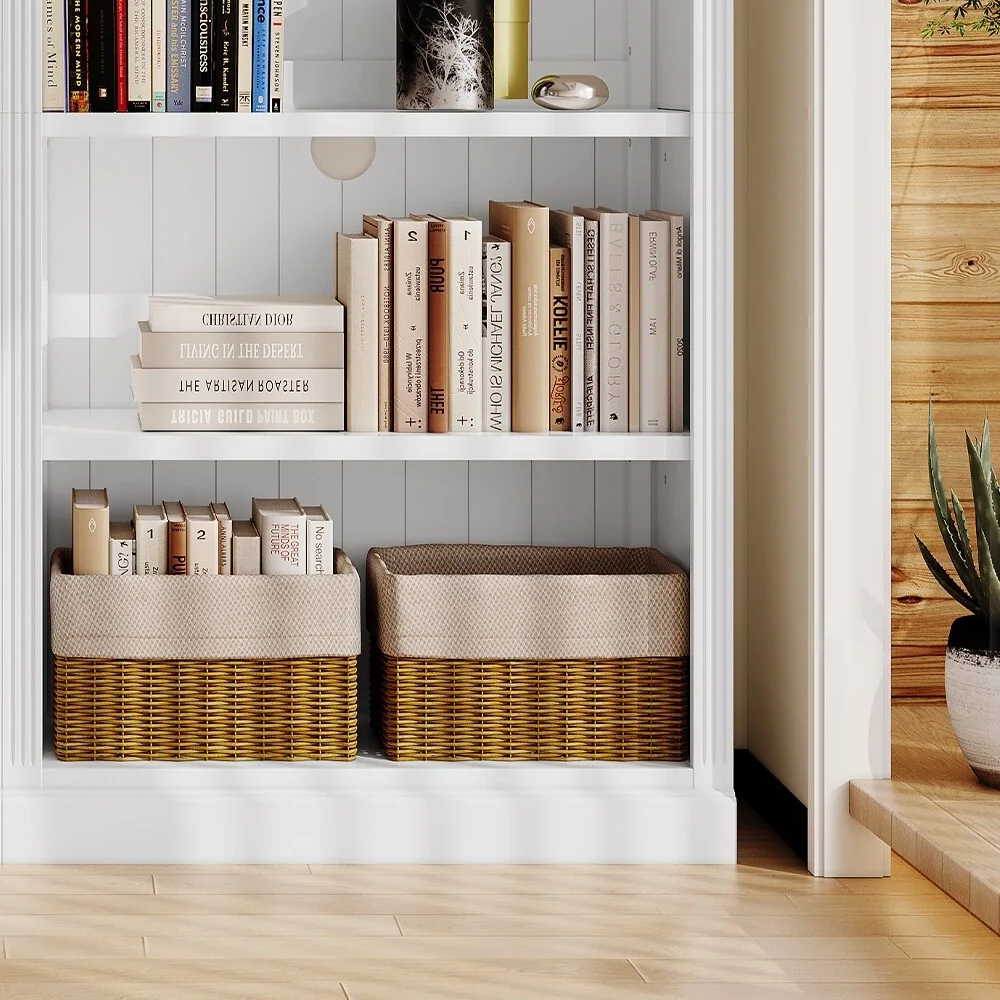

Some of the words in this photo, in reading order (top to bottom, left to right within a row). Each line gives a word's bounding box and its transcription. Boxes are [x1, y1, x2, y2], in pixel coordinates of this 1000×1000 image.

[241, 4, 249, 25] MARVIN
[47, 37, 55, 48] of
[241, 26, 249, 47] MINSKY
[47, 52, 57, 88] Mind
[222, 58, 229, 66] R.
[147, 529, 153, 539] 1
[197, 530, 206, 540] 2
[271, 524, 279, 555] FUTURE
[281, 524, 289, 549] MINDS
[291, 524, 299, 539] THE
[315, 527, 324, 540] No
[281, 551, 289, 561] OF
[291, 540, 299, 567] GREAT
[315, 543, 324, 574] search
